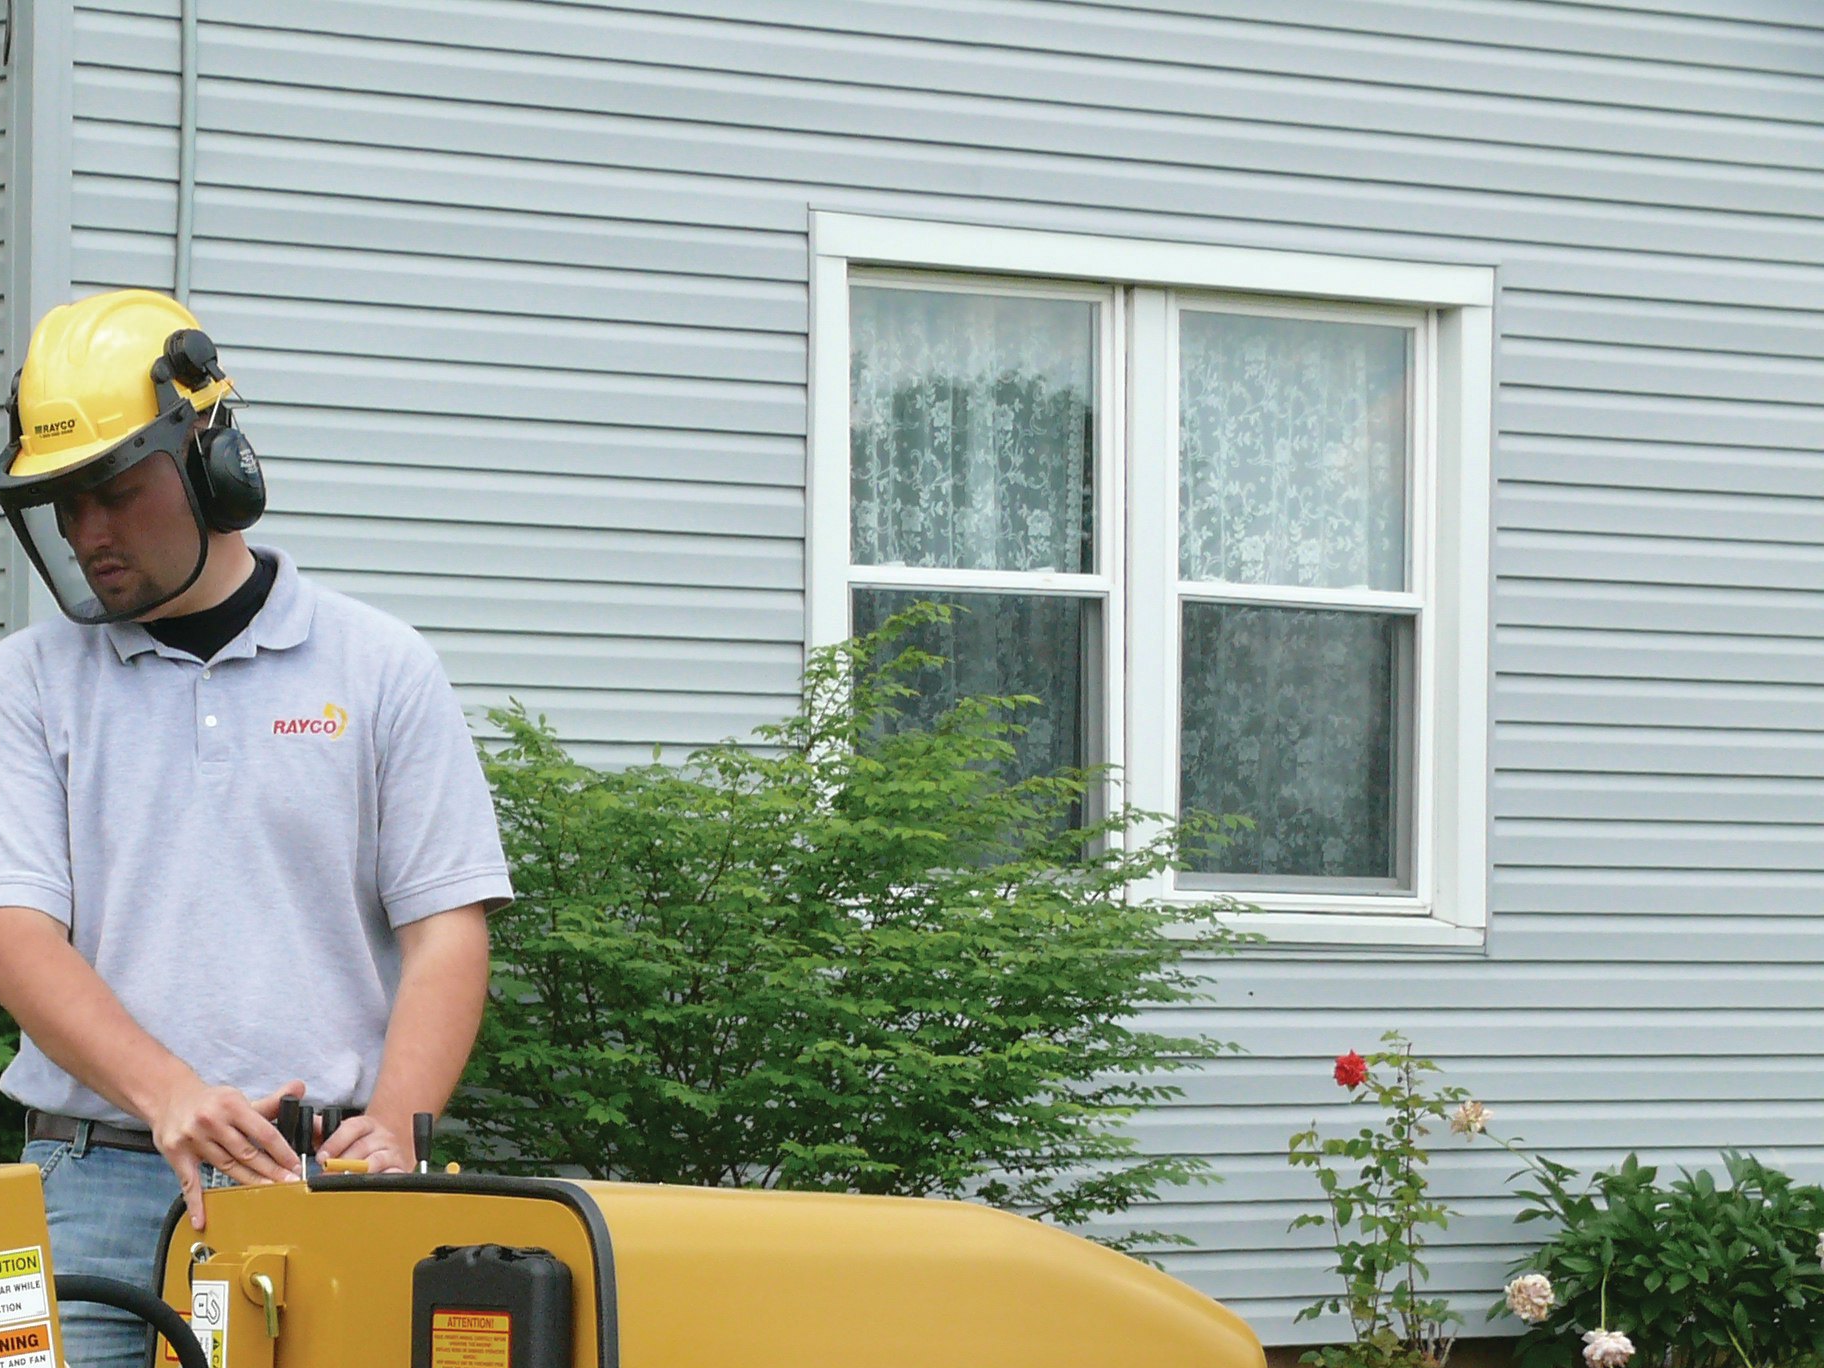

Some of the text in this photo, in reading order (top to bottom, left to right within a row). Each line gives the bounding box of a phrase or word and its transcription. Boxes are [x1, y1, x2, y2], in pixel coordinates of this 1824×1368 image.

[43, 419, 75, 433] RAYCO
[273, 719, 337, 735] RAYCO
[14, 1280, 41, 1292] WHILE
[447, 1316, 494, 1329] ATTENTION!
[8, 1358, 26, 1367] AND
[29, 1354, 46, 1364] FAN
